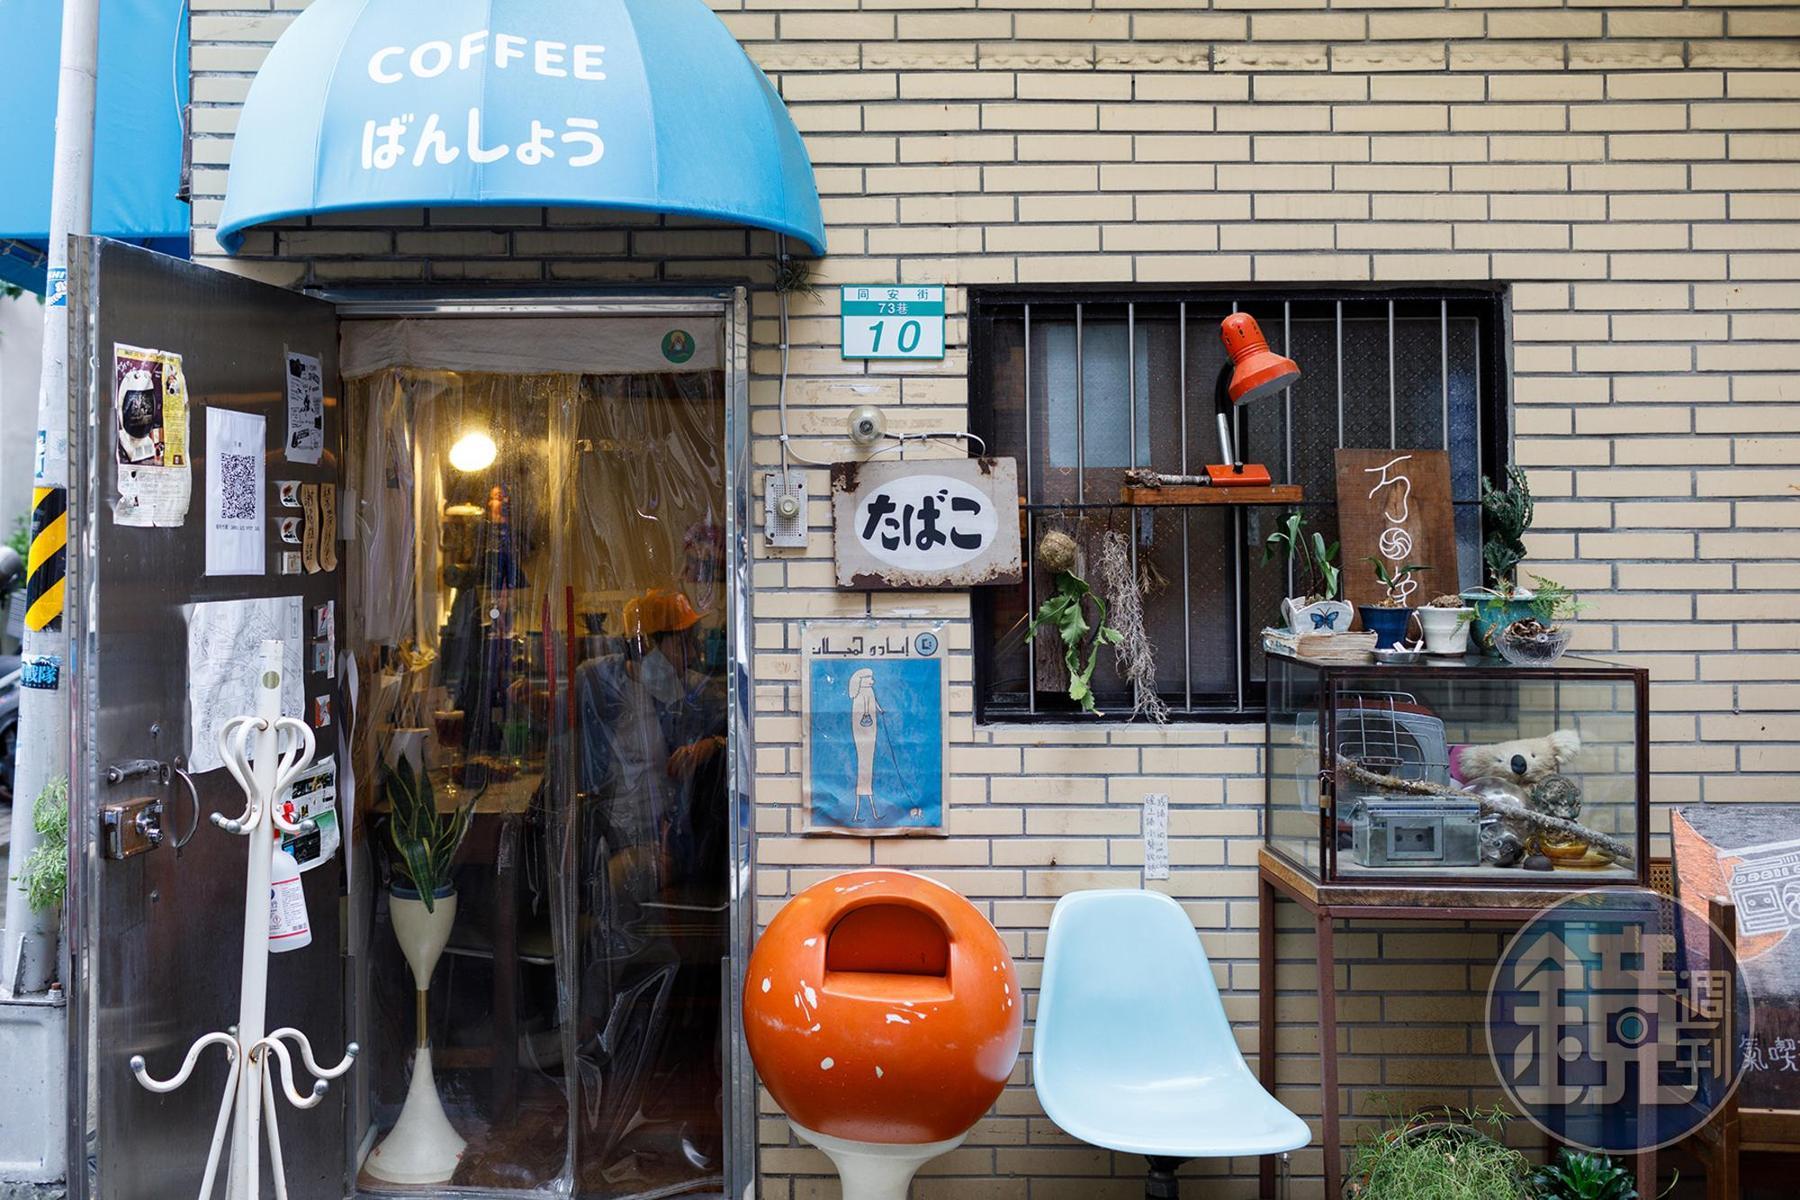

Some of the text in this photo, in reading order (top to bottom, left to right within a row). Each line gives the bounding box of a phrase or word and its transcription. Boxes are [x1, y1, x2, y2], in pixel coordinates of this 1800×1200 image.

[367, 29, 607, 85] COFFEE
[361, 107, 605, 170] ばんしょう
[857, 288, 929, 301] 同安街
[878, 302, 909, 315] 73巷
[868, 320, 921, 353] 10
[862, 488, 982, 551] たばこ
[1739, 1034, 1800, 1072] 氣喫
